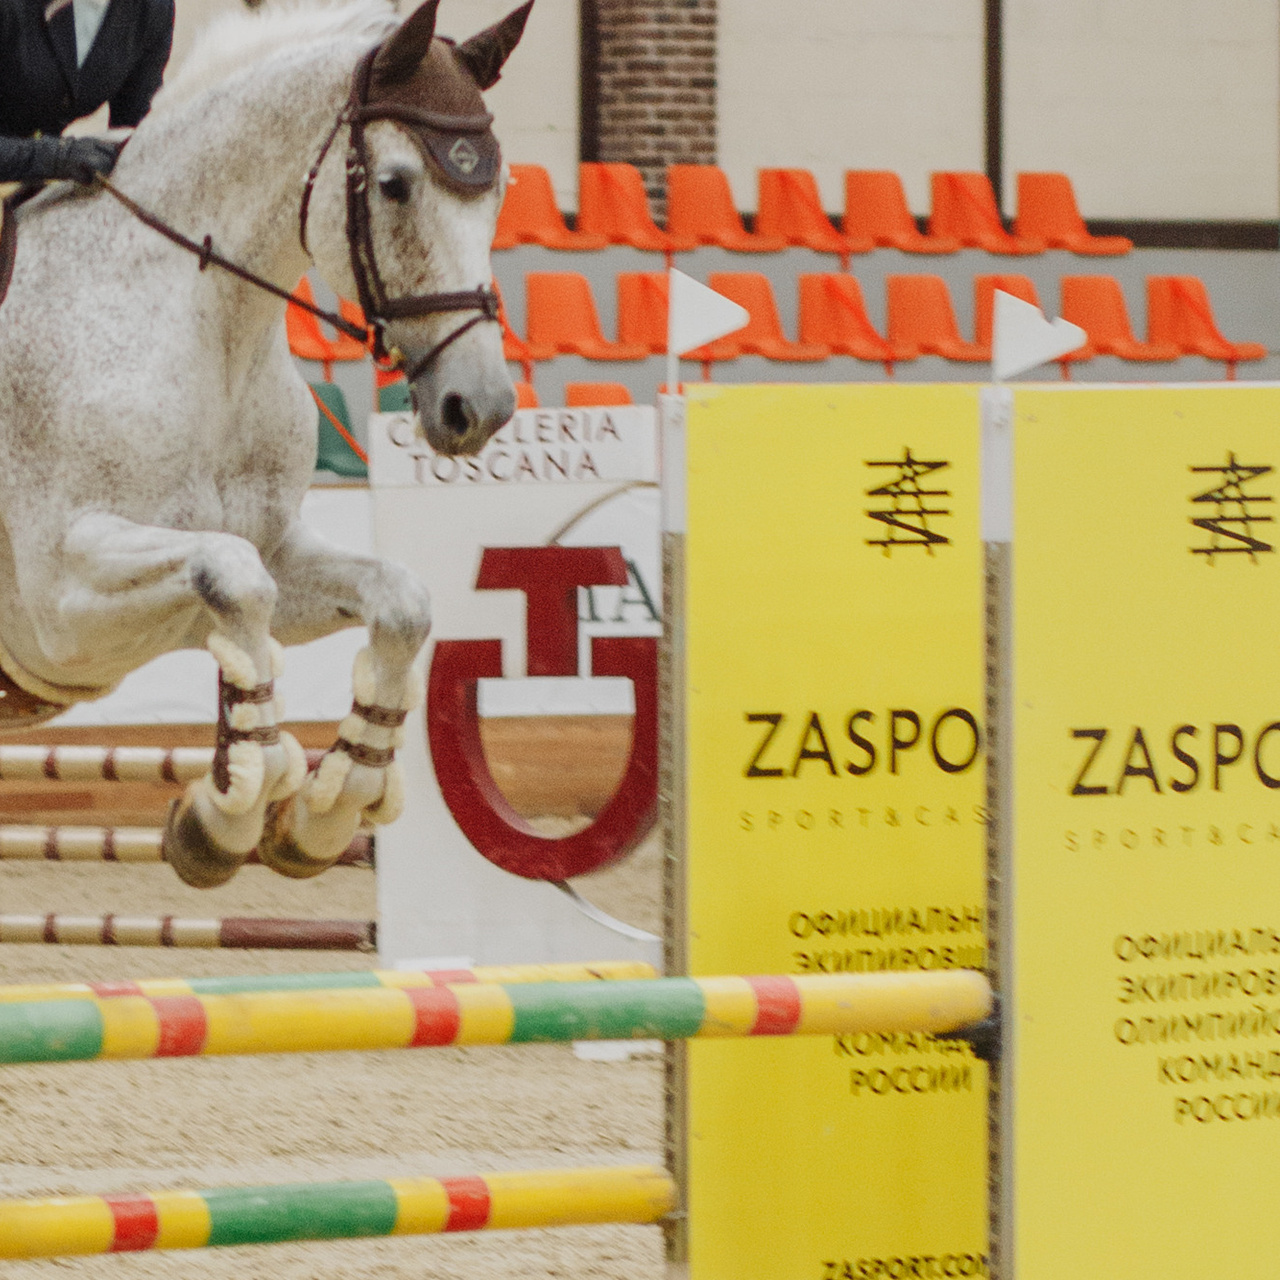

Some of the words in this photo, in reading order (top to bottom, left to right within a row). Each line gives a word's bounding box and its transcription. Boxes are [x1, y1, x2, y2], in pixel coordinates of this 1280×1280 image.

[387, 411, 621, 447] CLERIA
[409, 449, 600, 484] TOSCANA
[743, 707, 980, 779] ZASPO
[850, 1064, 972, 1096] РОССИИ
